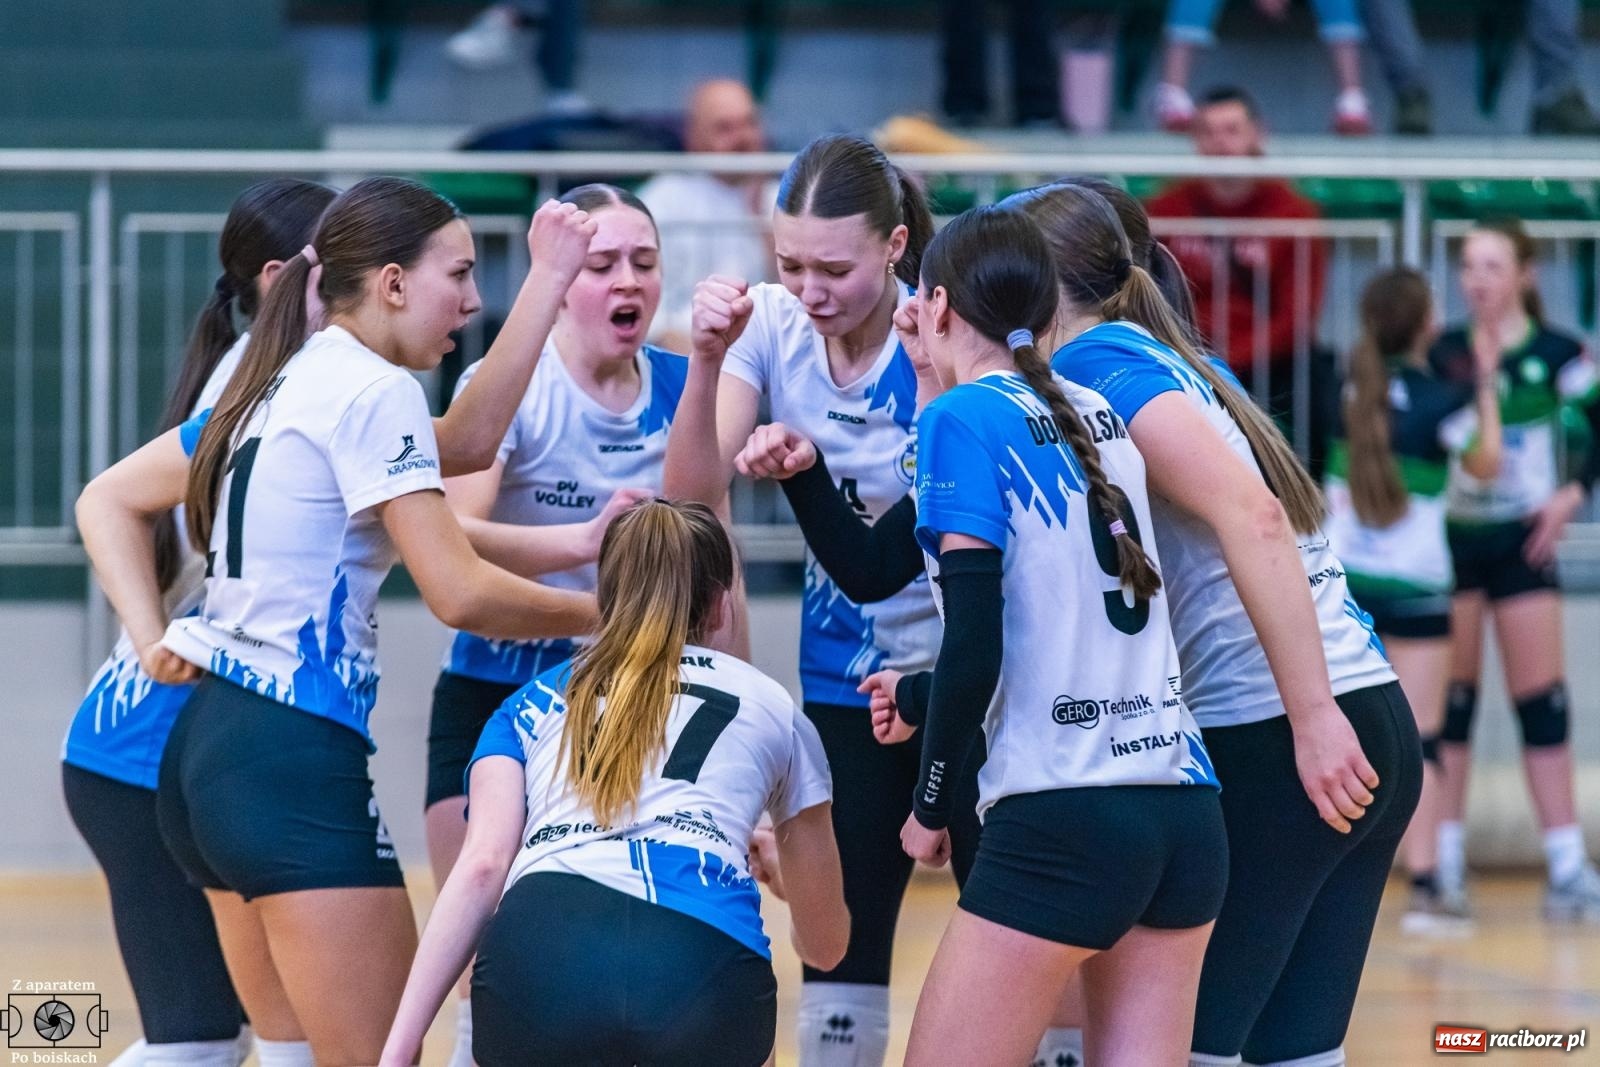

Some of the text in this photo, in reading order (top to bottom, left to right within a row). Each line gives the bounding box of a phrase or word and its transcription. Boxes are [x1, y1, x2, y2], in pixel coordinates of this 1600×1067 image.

[204, 437, 262, 579] 1
[535, 491, 596, 508] VOLLEY
[1087, 484, 1150, 635] 9
[1054, 694, 1180, 722] GERO Technik PAUL
[924, 760, 946, 804] KIPSTA
[655, 815, 674, 824] PAUL
